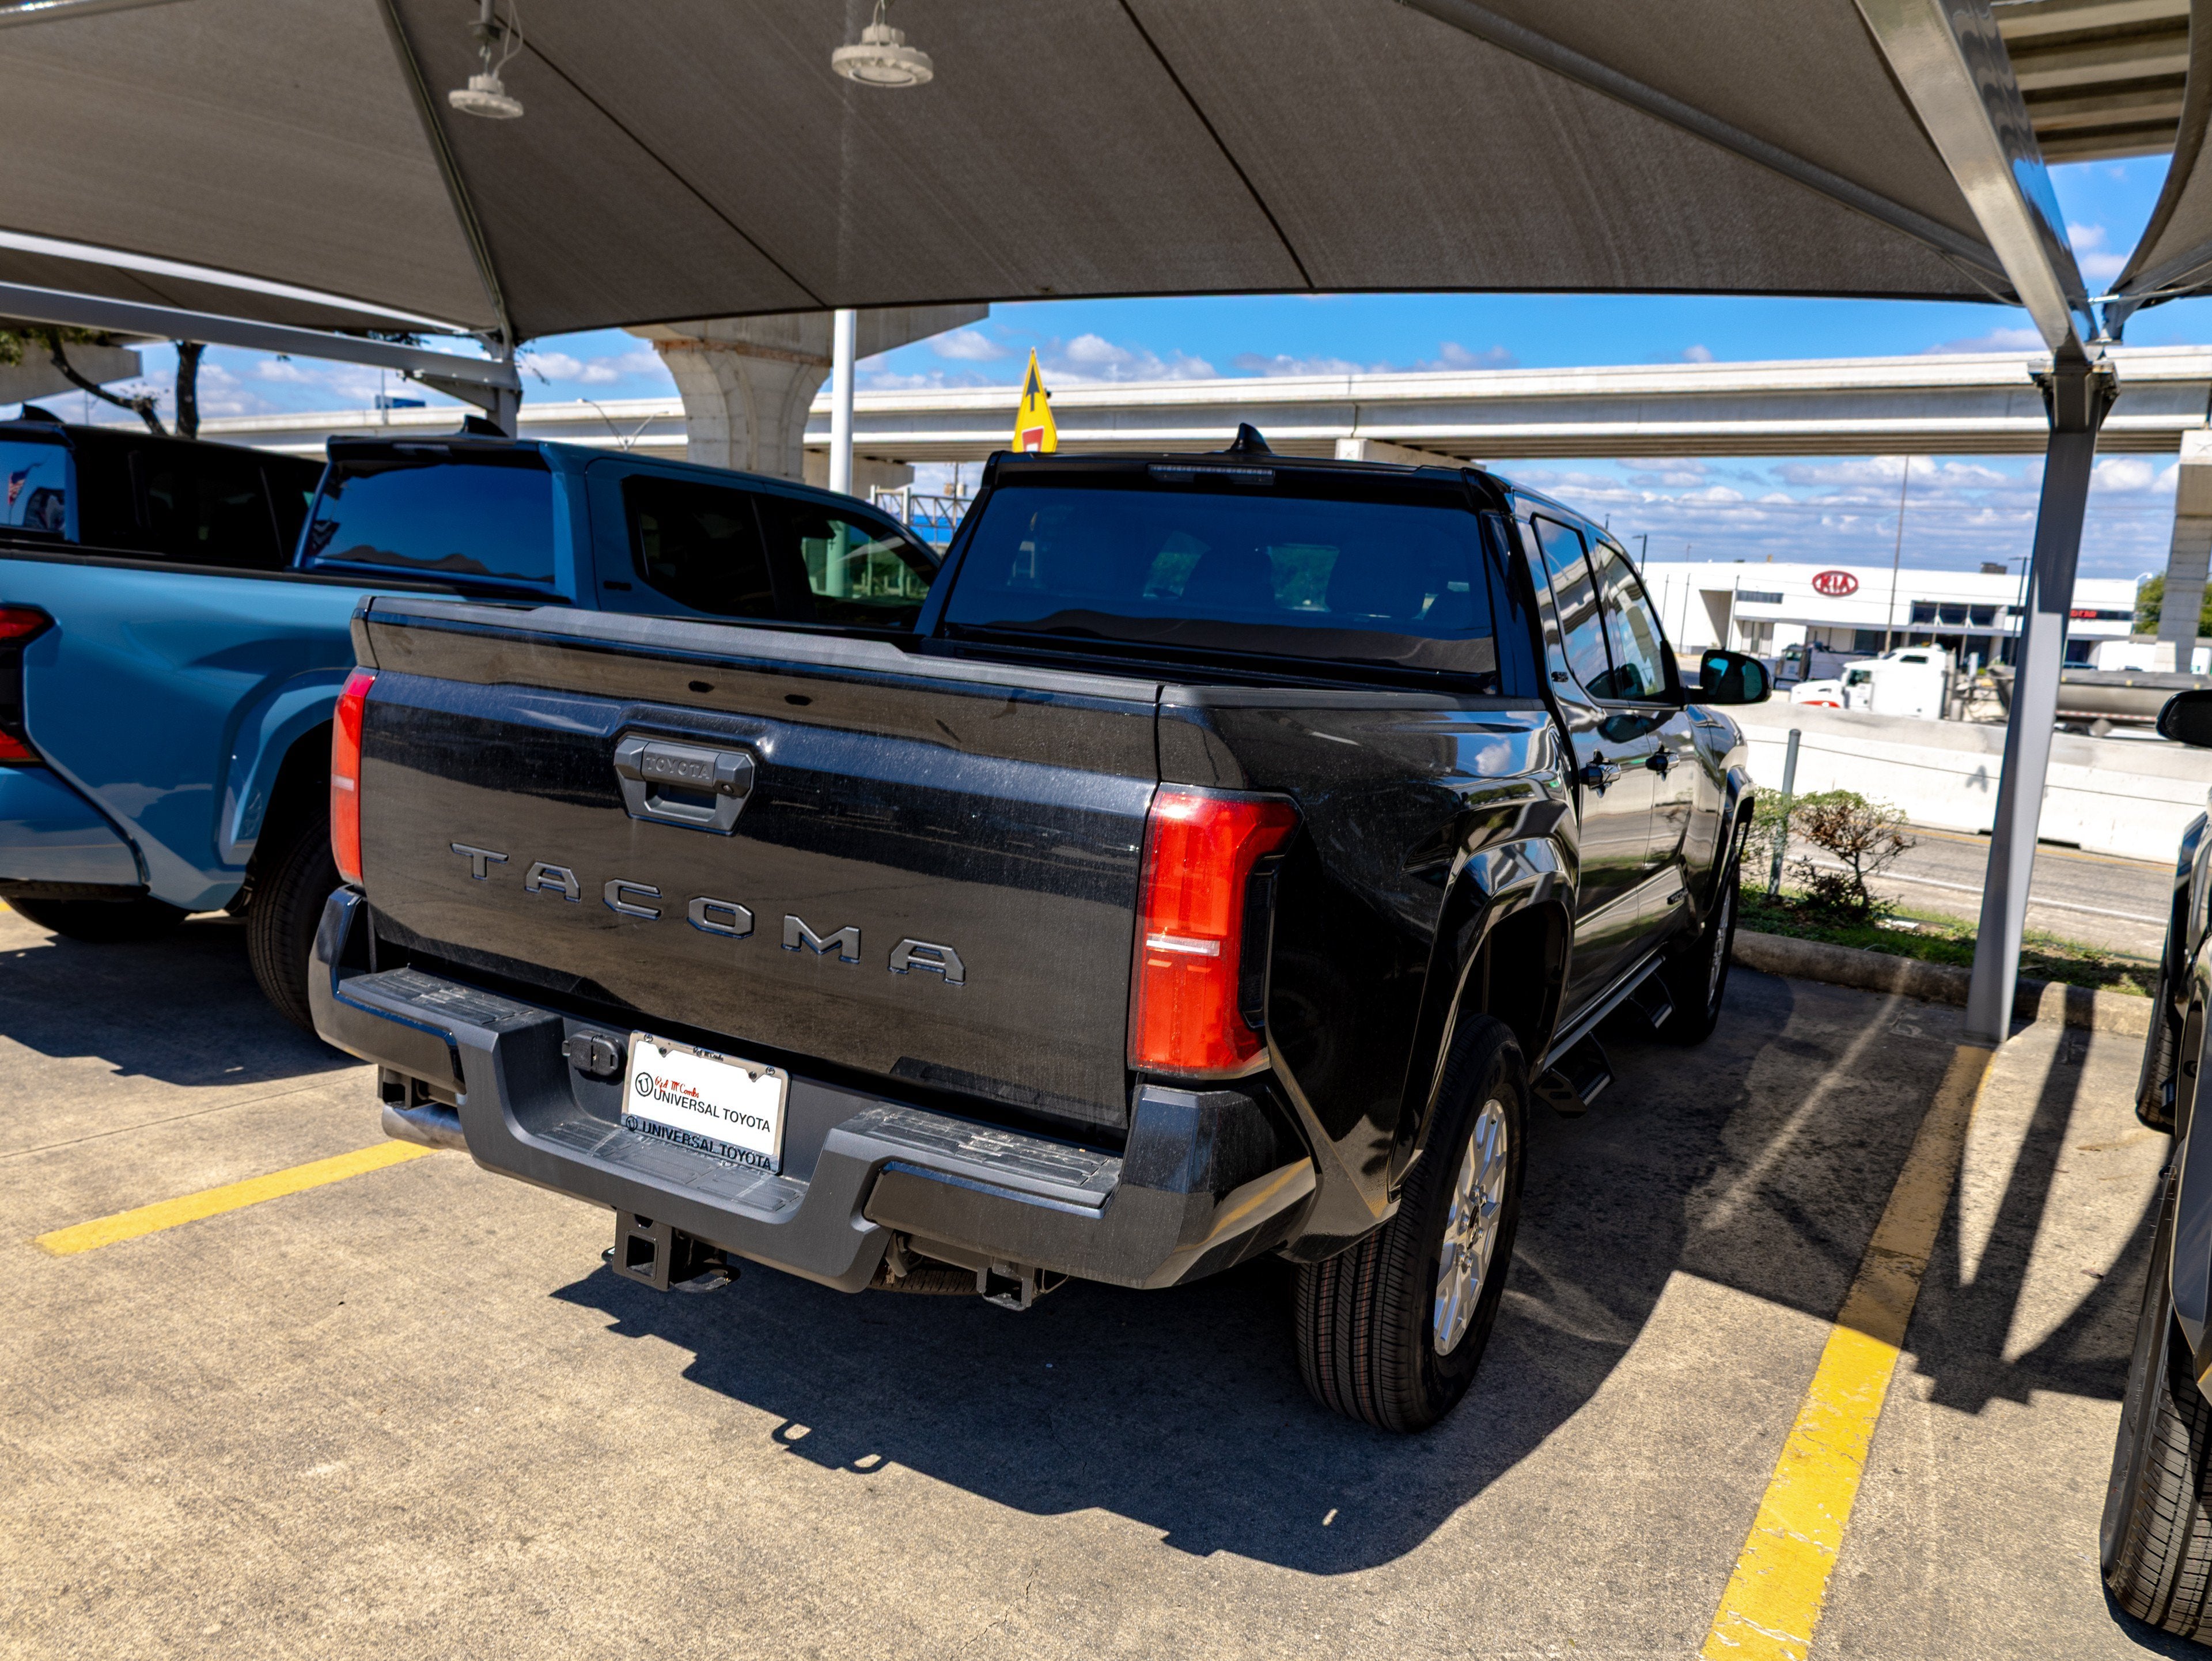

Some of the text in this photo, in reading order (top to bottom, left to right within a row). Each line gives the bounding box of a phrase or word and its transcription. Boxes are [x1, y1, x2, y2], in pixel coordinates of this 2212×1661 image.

[1819, 575, 1852, 593] KIA
[646, 755, 710, 780] TOYOTA
[450, 842, 966, 986] TACOMA
[655, 1076, 669, 1093] Red
[654, 1088, 770, 1133] UNIVERSAL TOYOTA
[642, 1121, 771, 1170] UNIVERSAL TOYOTA
